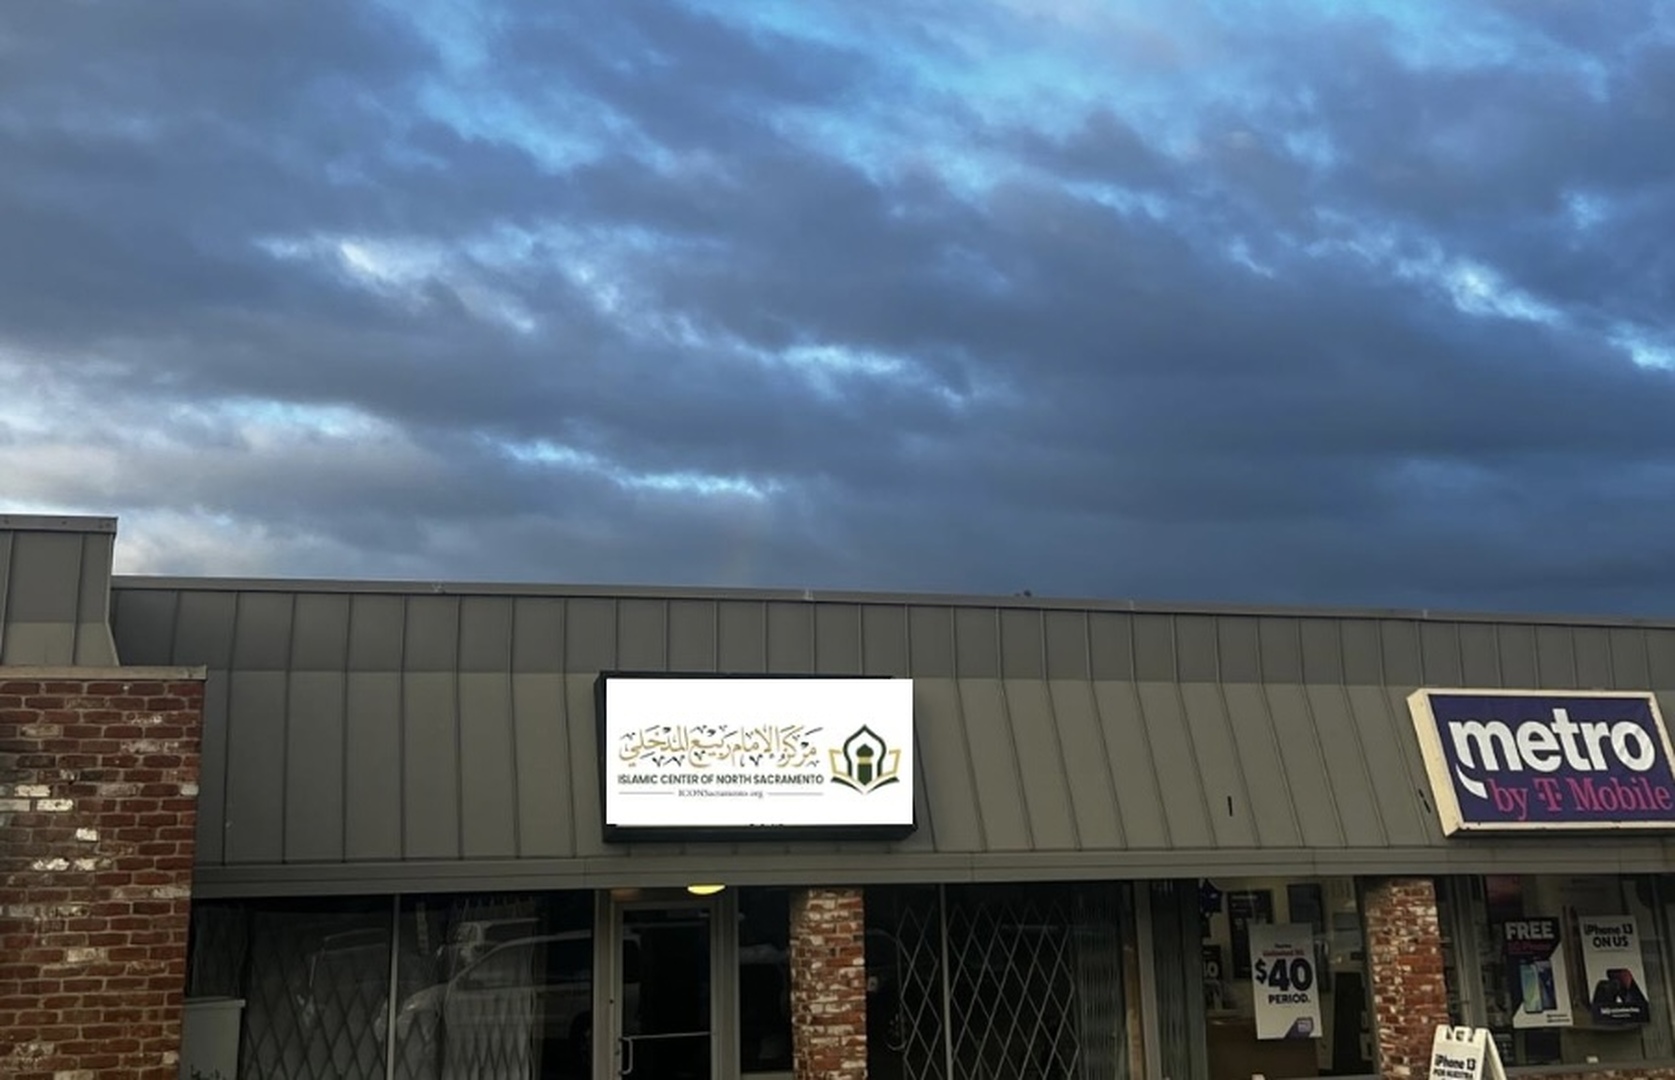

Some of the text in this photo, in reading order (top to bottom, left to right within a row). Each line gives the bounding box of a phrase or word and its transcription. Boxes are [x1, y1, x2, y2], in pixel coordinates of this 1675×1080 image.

[1449, 708, 1656, 773] metro
[618, 774, 824, 785] ISLAMIC CENTER OF NORTH SACRAMENTO
[678, 789, 764, 799] ICONSacramento.org
[1488, 778, 1528, 821] by
[1505, 921, 1555, 940] FREE
[1584, 923, 1634, 936] iPhone 13
[1593, 935, 1629, 948] ON US
[1255, 957, 1313, 991] $40
[1268, 993, 1311, 1004] PERIOD.
[1434, 1054, 1476, 1071] iPhone 13
